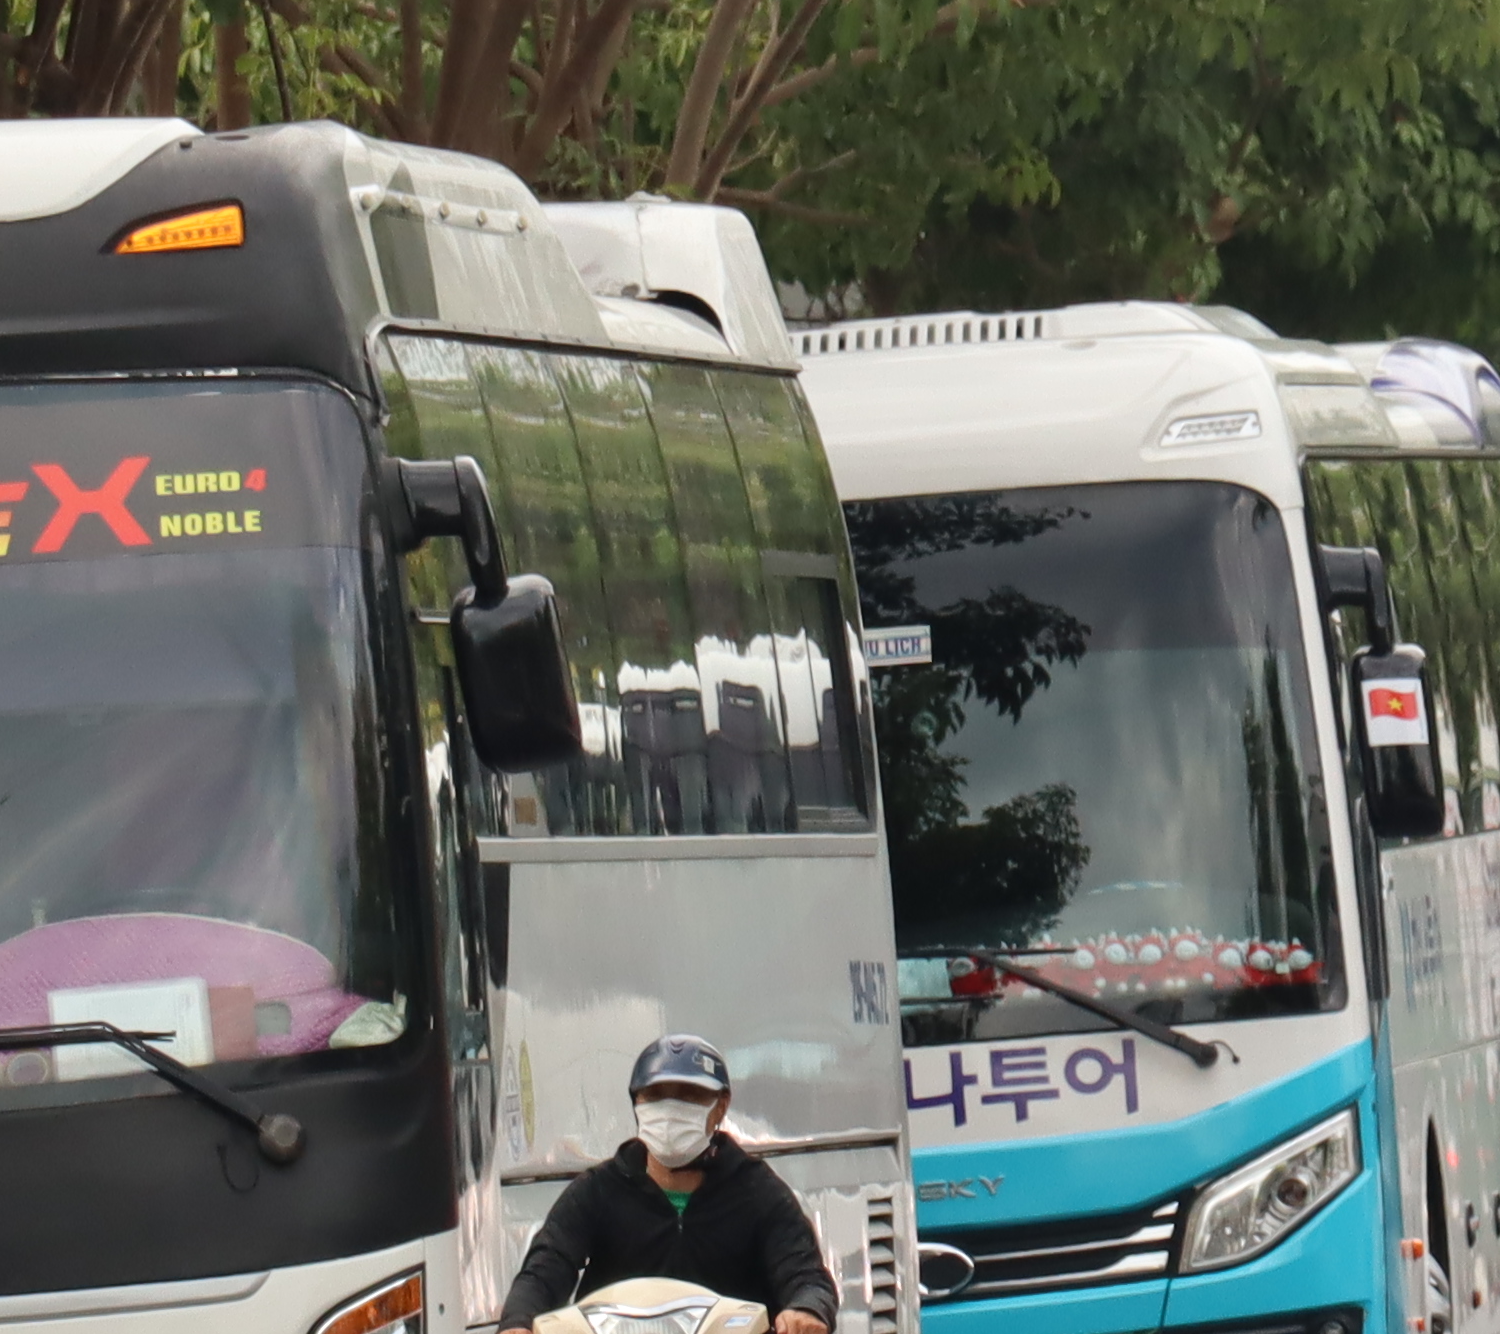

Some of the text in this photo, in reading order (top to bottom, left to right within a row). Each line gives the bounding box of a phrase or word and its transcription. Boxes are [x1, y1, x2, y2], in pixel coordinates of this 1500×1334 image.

[155, 468, 267, 497] EURO 4
[160, 510, 262, 538] NOBLE
[902, 1038, 1139, 1127] 나투어
